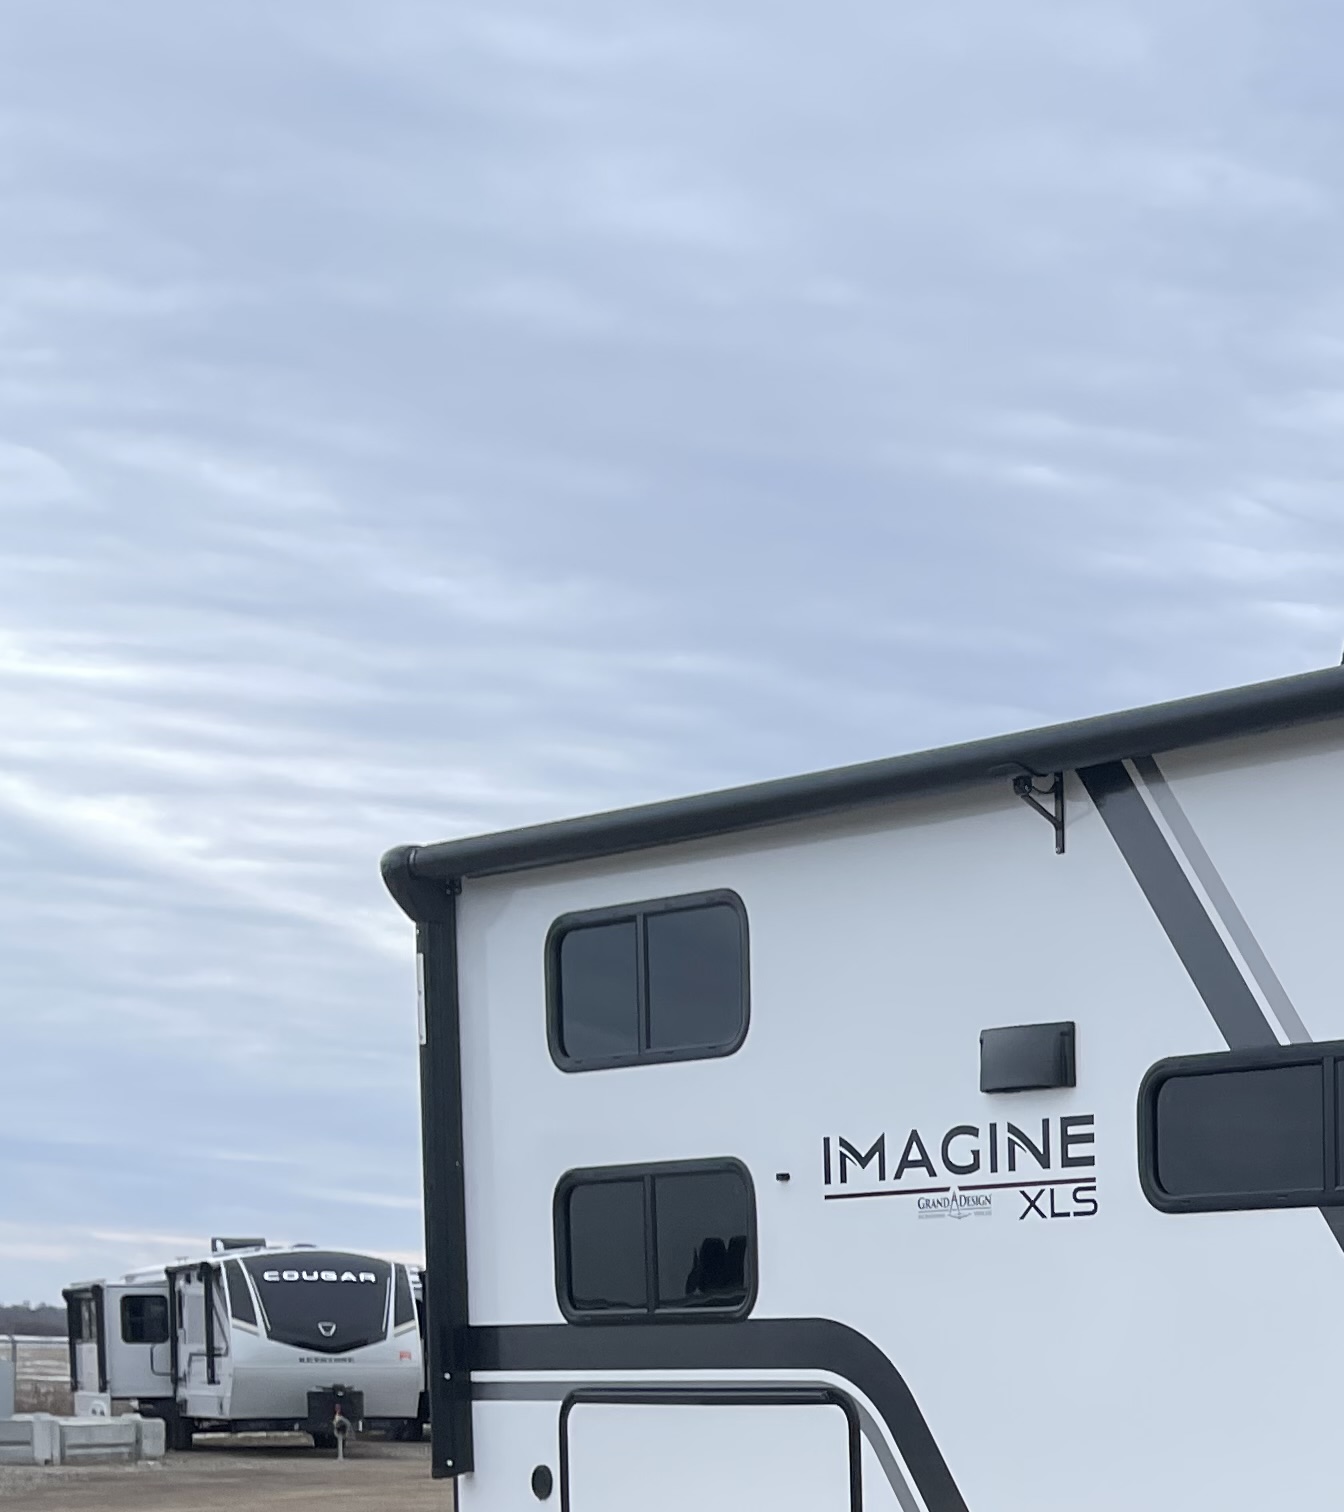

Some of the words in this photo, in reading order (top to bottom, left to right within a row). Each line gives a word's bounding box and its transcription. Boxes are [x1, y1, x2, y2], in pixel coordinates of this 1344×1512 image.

[823, 1114, 1096, 1186] IMAGINE
[917, 1196, 950, 1210] GRAND
[959, 1193, 992, 1207] DESIGN
[1019, 1185, 1098, 1221] XLS
[263, 1270, 376, 1284] COUGAR
